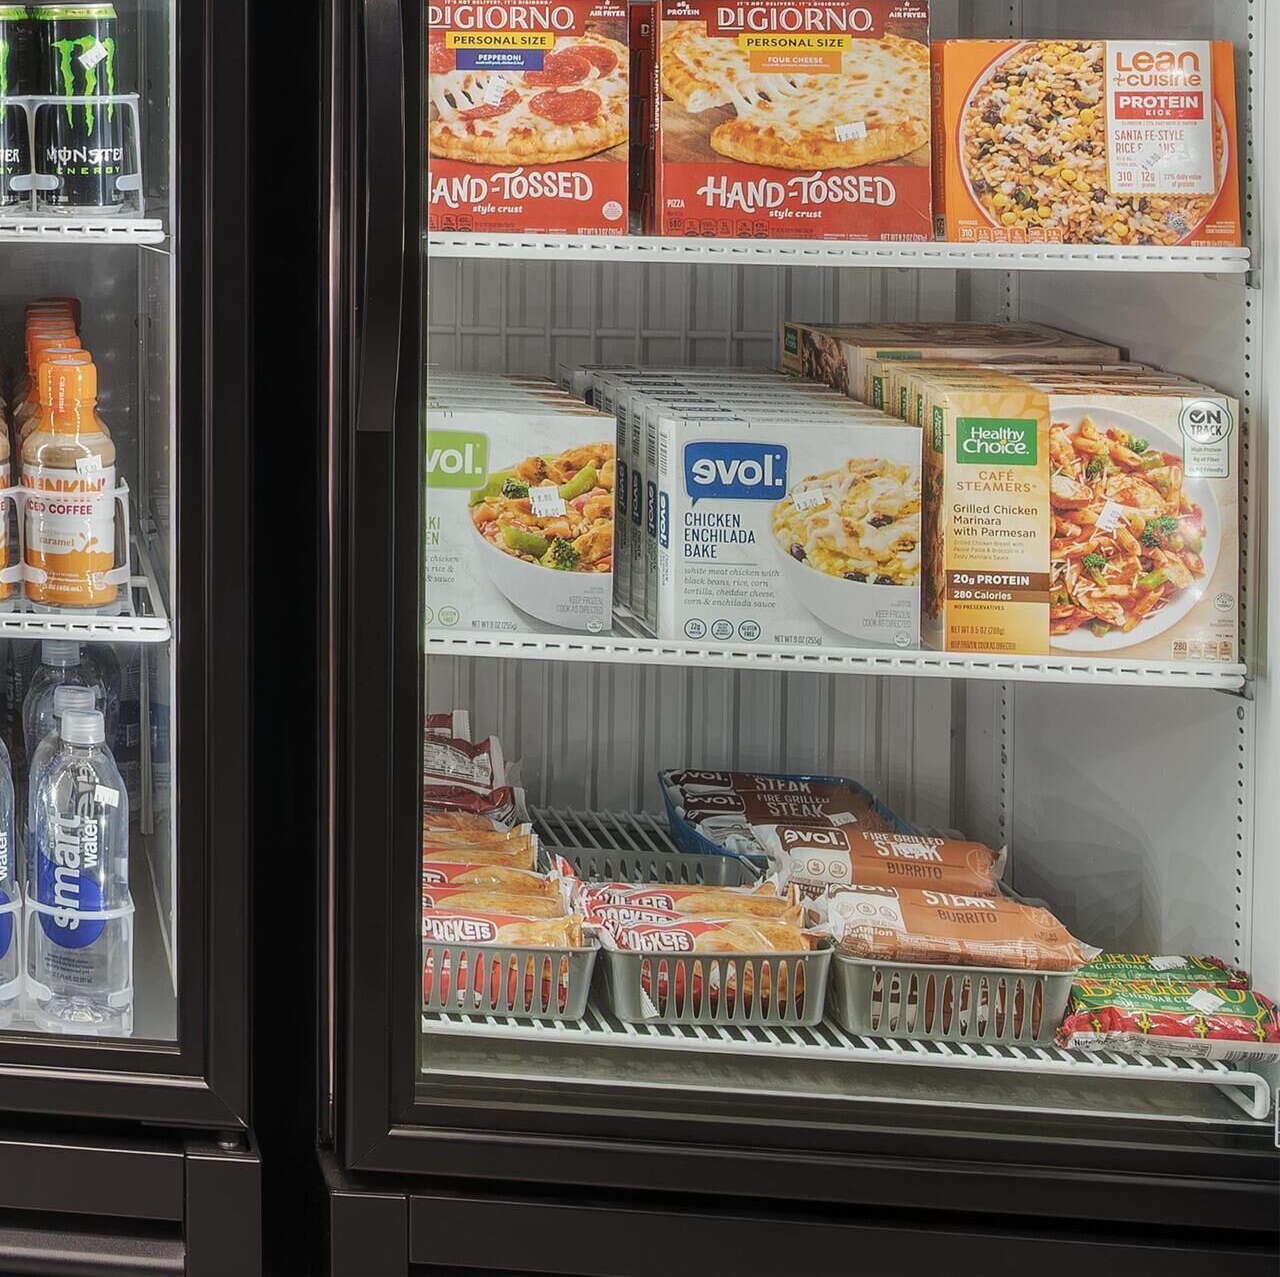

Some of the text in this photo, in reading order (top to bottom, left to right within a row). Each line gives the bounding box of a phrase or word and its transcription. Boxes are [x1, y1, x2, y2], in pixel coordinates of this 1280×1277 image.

[454, 36, 517, 44] PERSONAL
[747, 38, 844, 47] PERSONAL SIZE
[1116, 51, 1200, 72] Lean
[1119, 96, 1199, 109] PROTEIN
[1115, 130, 1143, 140] SANTA
[1115, 143, 1137, 153] RICE
[1118, 172, 1132, 181] 310
[697, 172, 896, 214] HAND-TOSSED
[472, 204, 523, 215] style crust
[667, 199, 685, 209] PIZZA
[971, 426, 1025, 443] Healthy
[1190, 424, 1222, 436] TRACK
[957, 482, 1031, 493] STEAMERS
[953, 504, 1038, 515] Grilled Chicken
[684, 513, 742, 529] CHICKEN
[953, 516, 1001, 526] Marinara
[684, 528, 756, 544] ENCHILADA
[953, 527, 1036, 538] with Parmesan
[684, 542, 717, 559] BAKE
[729, 568, 760, 576] chicken
[761, 569, 779, 577] with
[953, 574, 1030, 586] 20g PROTEIN
[954, 591, 1012, 600] 280 Calories
[755, 778, 810, 793] STEAK
[769, 803, 827, 818] STEAK
[887, 862, 943, 879] BURRITO
[937, 909, 998, 924] BURRITO
